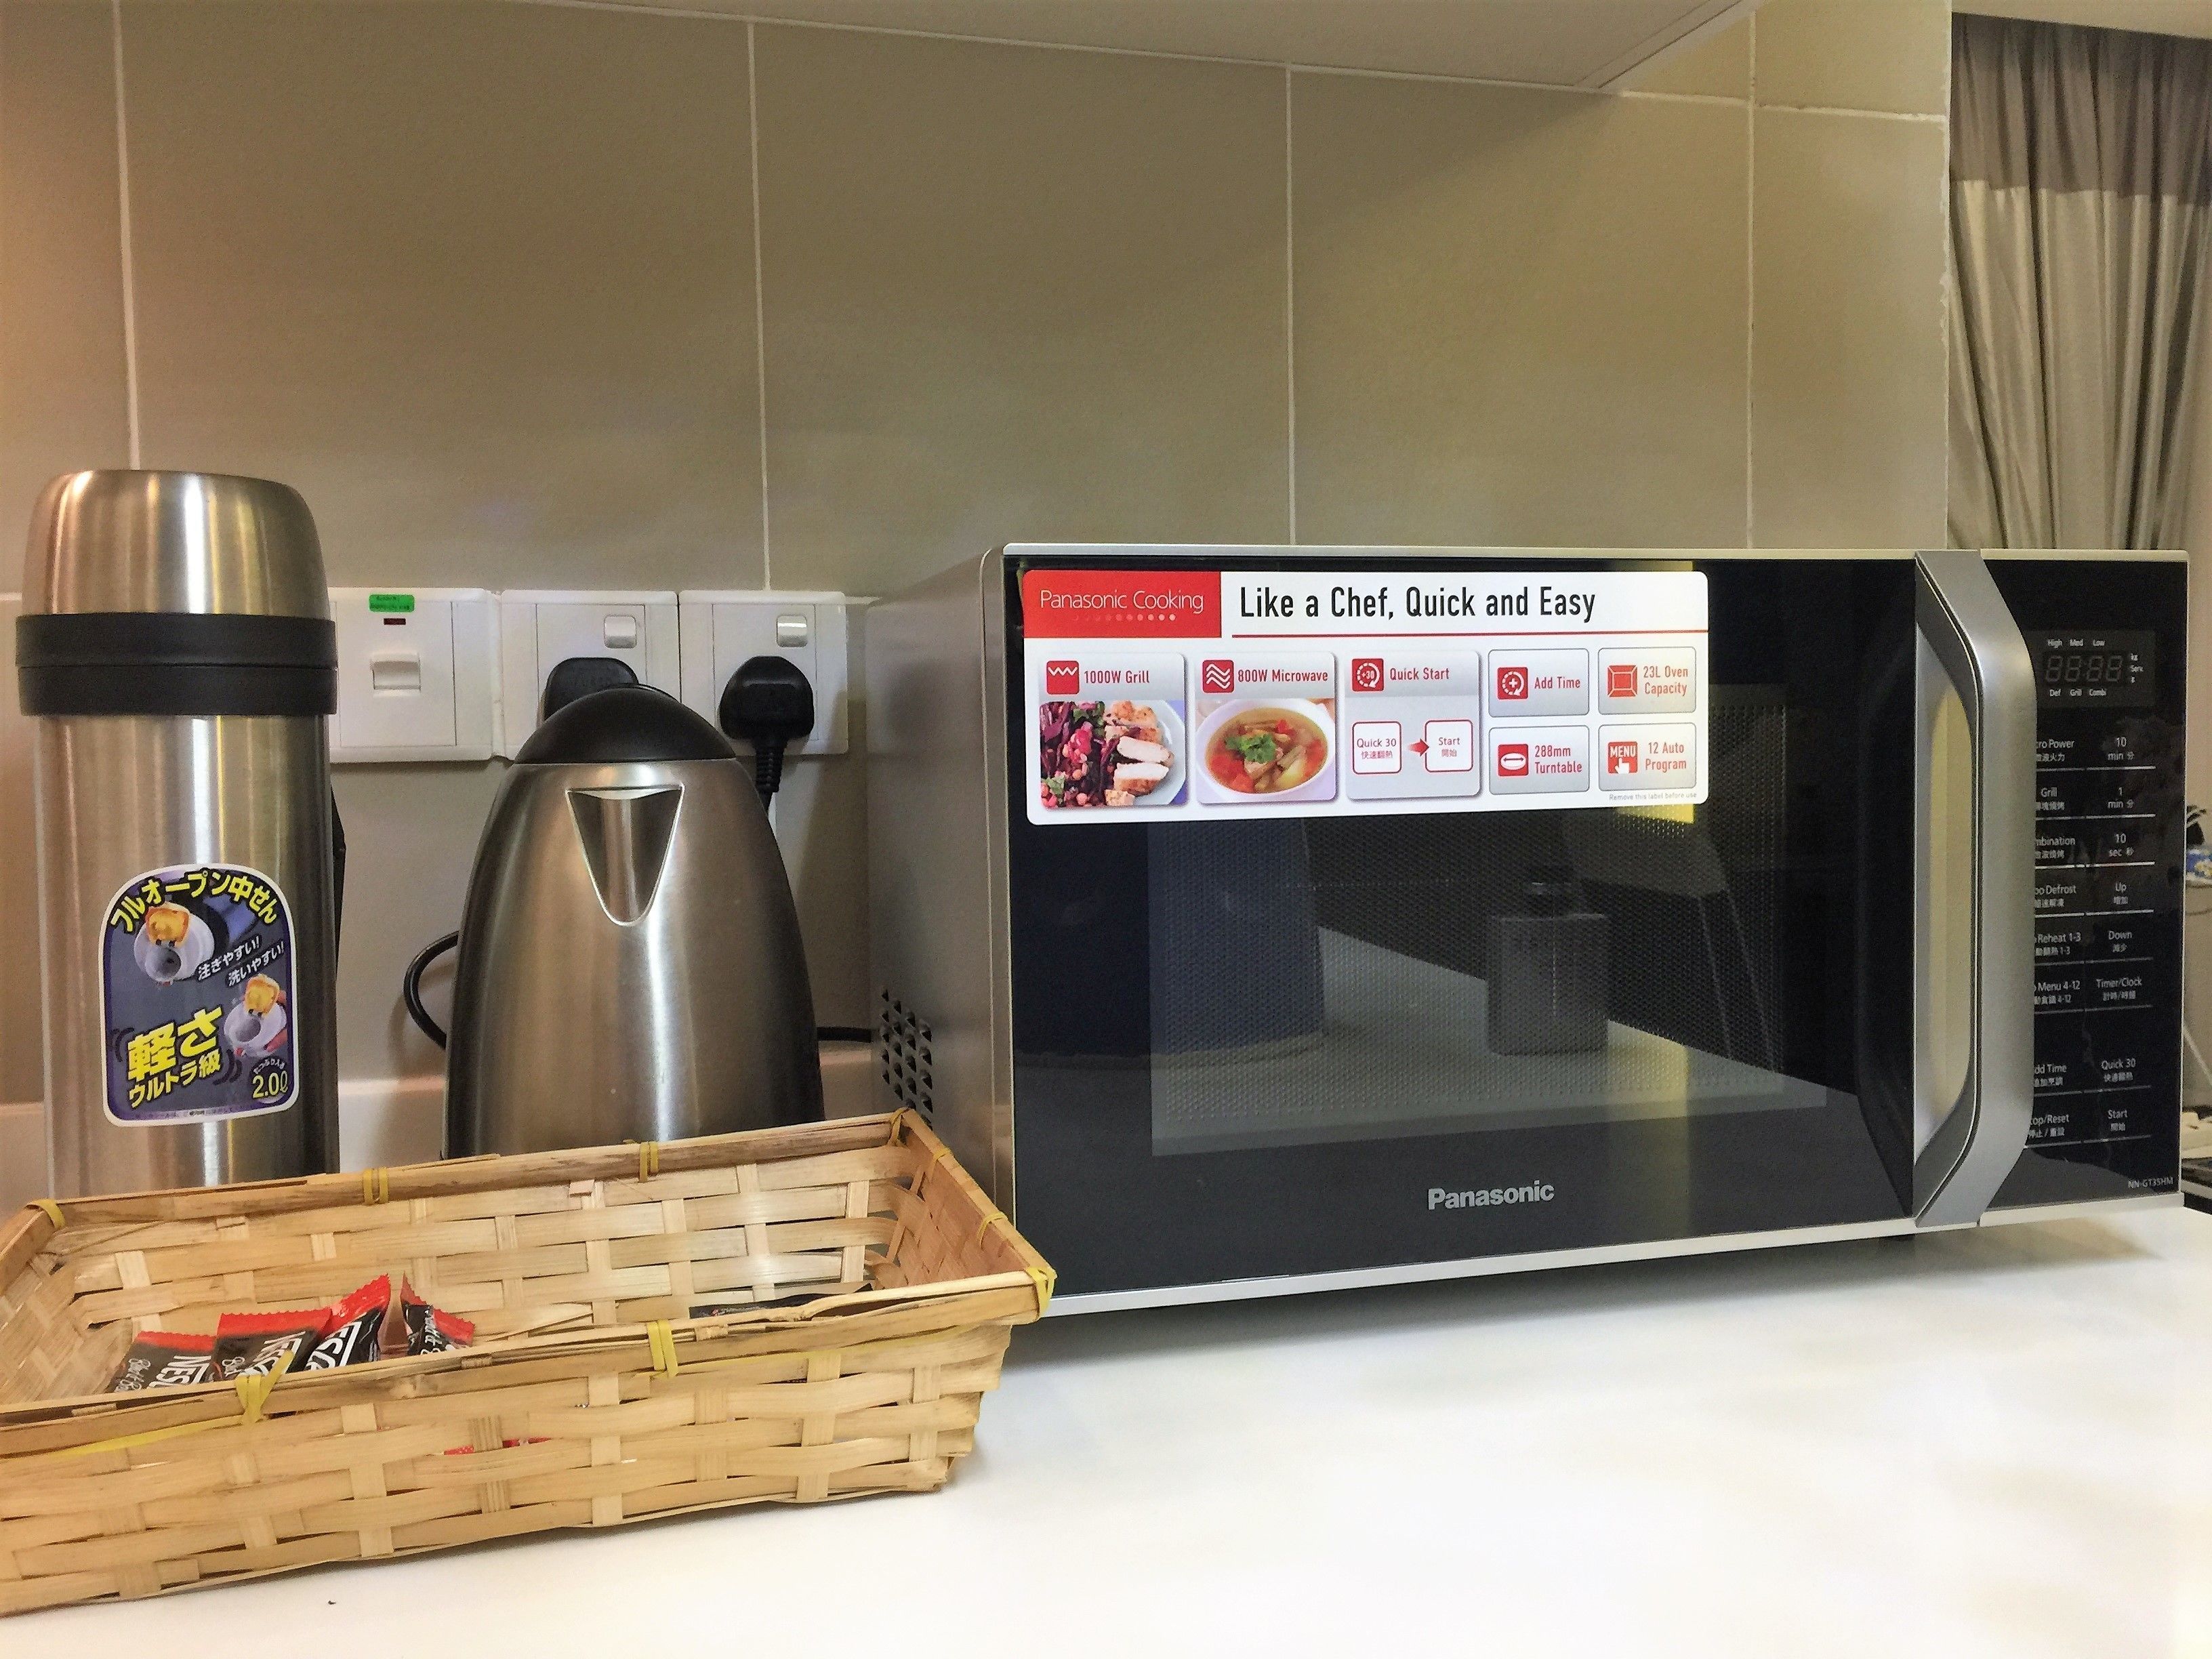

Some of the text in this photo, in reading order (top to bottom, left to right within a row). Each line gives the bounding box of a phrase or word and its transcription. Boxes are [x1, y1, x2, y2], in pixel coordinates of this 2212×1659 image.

[1040, 589, 1204, 614] Panasonic Cooking
[1240, 585, 1596, 623] Like a Chef, Quick and Easy
[1084, 670, 1150, 684] 1000W Grill
[1237, 668, 1328, 682] 800W Microwave
[1389, 667, 1450, 680] Quick Start
[1643, 665, 1689, 678] 23L Oven
[1534, 676, 1581, 689] Add Time
[1644, 682, 1687, 697] Capacity
[1357, 738, 1397, 748] Quick 30
[1438, 737, 1460, 746] Start
[1648, 741, 1684, 754] 12 Auto
[2049, 739, 2075, 749] Power
[2116, 736, 2127, 747] 10
[1534, 745, 1571, 758] 288mm
[1610, 745, 1636, 758] MENU
[2107, 751, 2124, 761] min
[1534, 760, 1582, 775] Turntable
[1645, 758, 1687, 773] Program
[2041, 787, 2057, 798] Grill
[2107, 798, 2124, 808] min
[2035, 836, 2076, 846] mbination
[2115, 833, 2127, 844] 10
[2108, 848, 2122, 857] sec
[2045, 884, 2077, 895] Defrost
[2114, 882, 2127, 893] Up
[110, 867, 280, 933] フルオープン中せん
[2037, 933, 2067, 943] Reheat
[2108, 930, 2133, 941] Down
[2037, 982, 2062, 992] Menu
[2096, 976, 2142, 989] Timer/Clock
[127, 1006, 224, 1082] 軽さ
[2034, 1063, 2067, 1075] dd Time
[2101, 1058, 2136, 1071] Quick 30
[128, 1048, 222, 1108] ウルトラ級
[2108, 1109, 2128, 1120] Start
[1427, 1179, 1555, 1210] Panasonic
